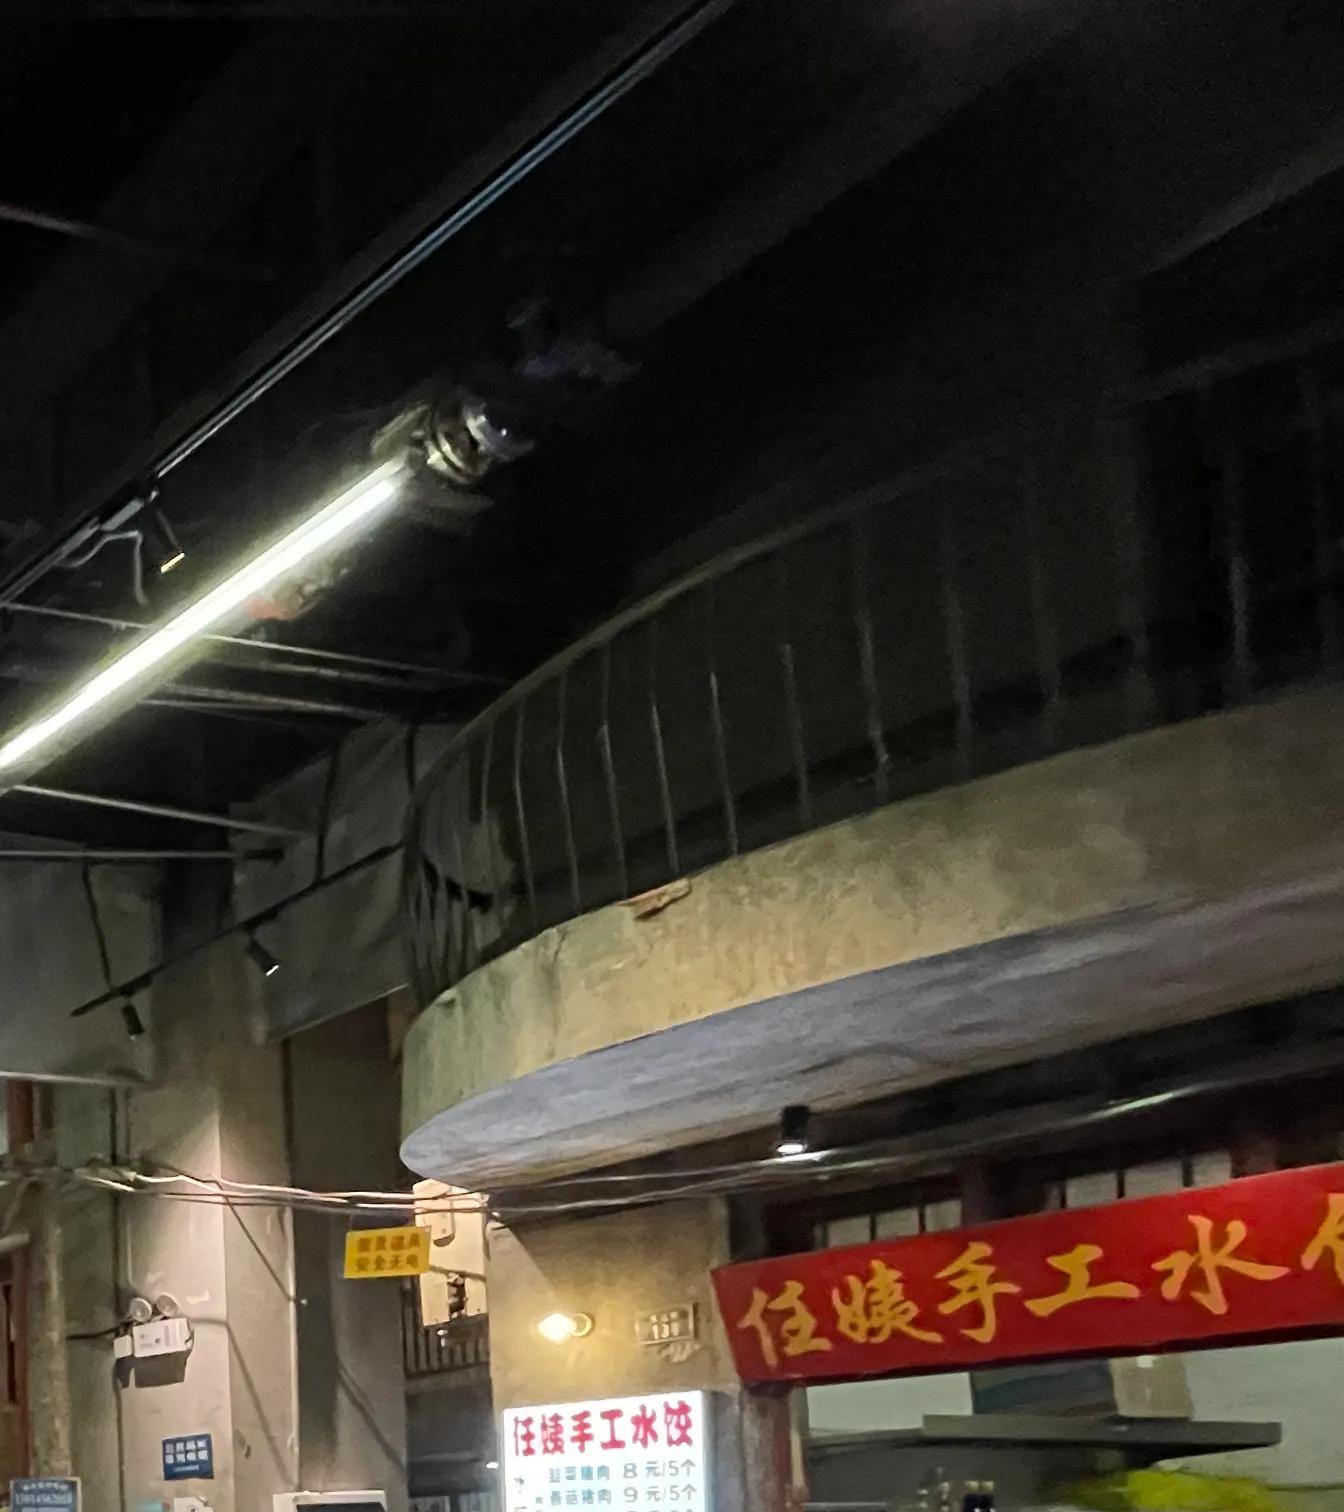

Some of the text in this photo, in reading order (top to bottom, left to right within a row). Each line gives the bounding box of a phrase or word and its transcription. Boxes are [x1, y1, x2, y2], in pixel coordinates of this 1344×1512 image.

[738, 1191, 1344, 1368] 任姨手工水
[514, 1400, 694, 1456] 任姨手工水饺
